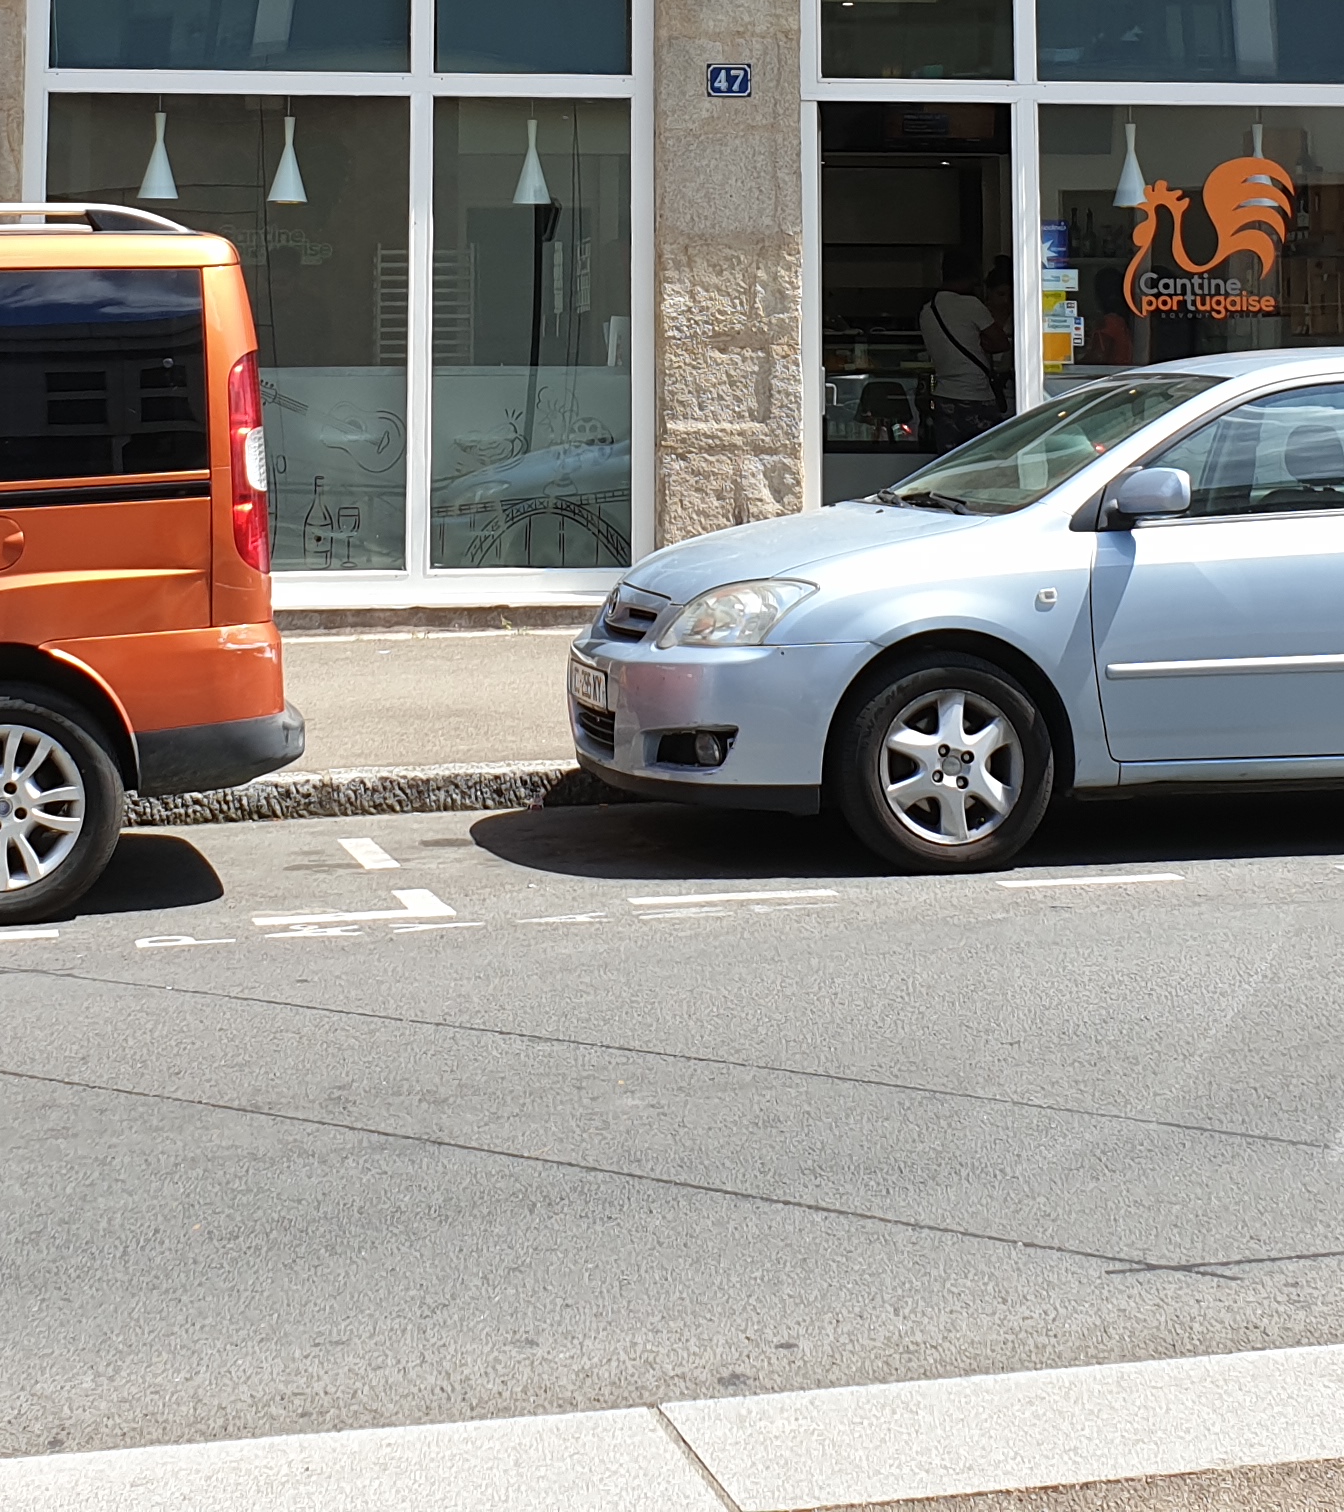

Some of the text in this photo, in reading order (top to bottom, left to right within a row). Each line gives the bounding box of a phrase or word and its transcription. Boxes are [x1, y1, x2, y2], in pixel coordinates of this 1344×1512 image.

[713, 69, 745, 92] 47
[1139, 272, 1242, 295] Cantine
[1141, 290, 1277, 319] portugaise
